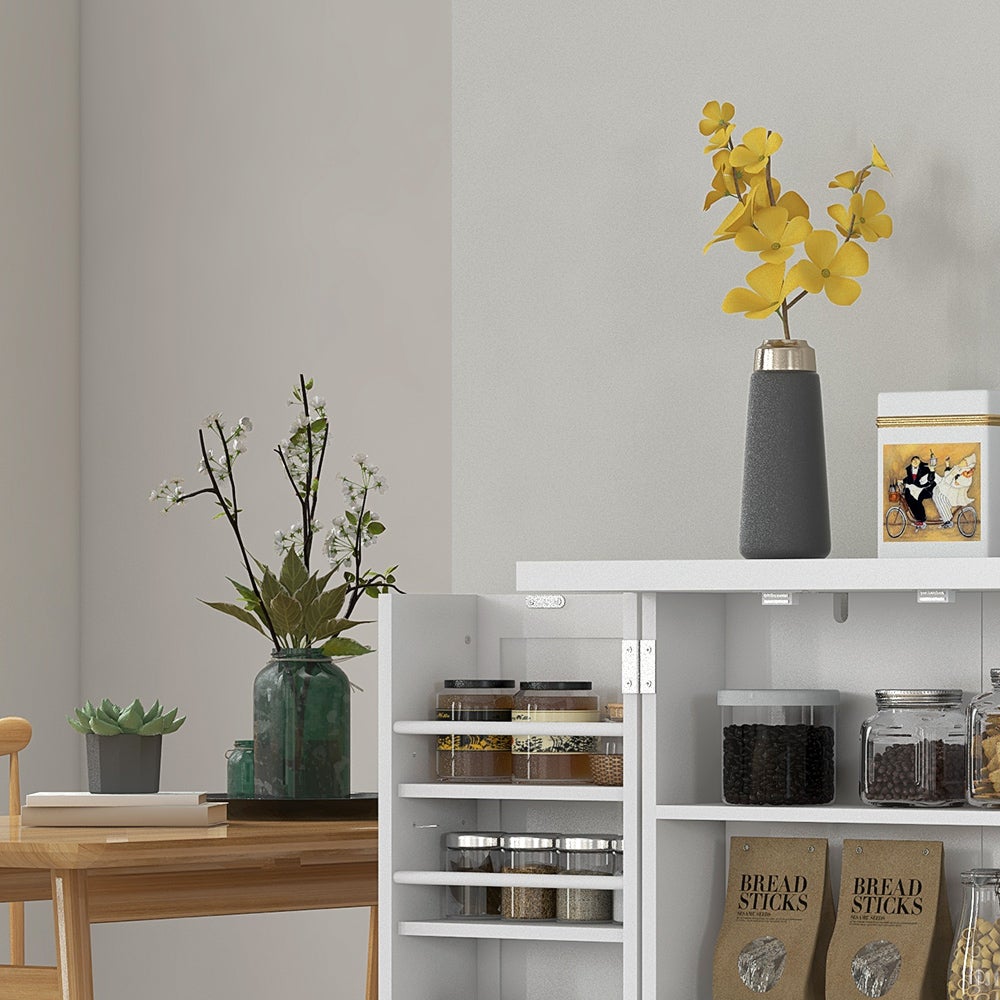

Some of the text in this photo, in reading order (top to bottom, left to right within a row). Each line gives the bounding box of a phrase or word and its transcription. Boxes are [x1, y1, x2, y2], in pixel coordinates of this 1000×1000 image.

[739, 874, 807, 893] BREAD
[852, 877, 922, 896] BREAD
[737, 892, 808, 912] STICKS
[850, 896, 923, 915] STICKS
